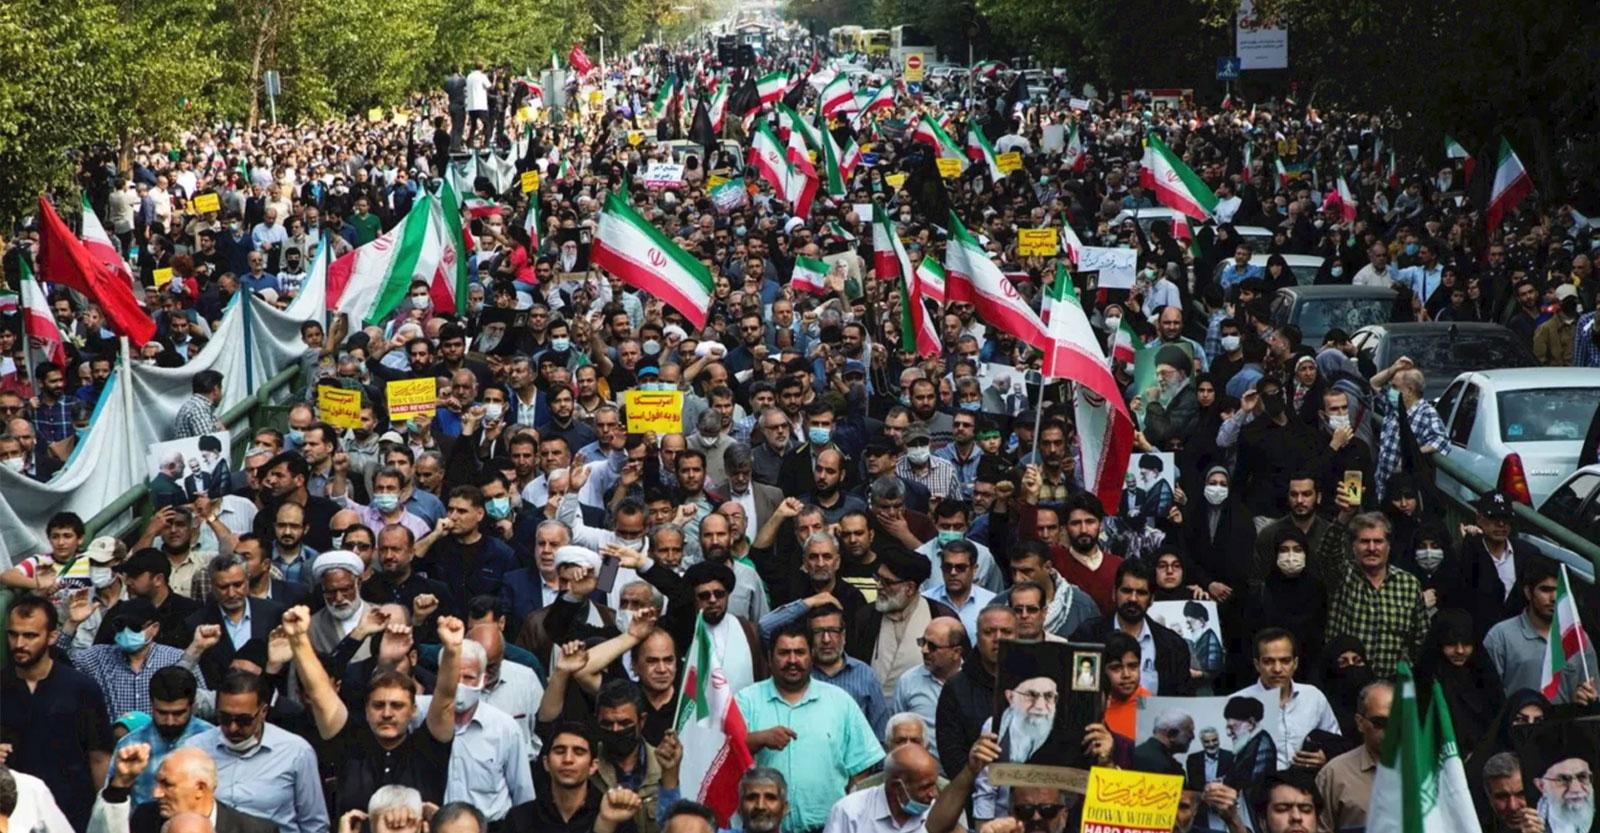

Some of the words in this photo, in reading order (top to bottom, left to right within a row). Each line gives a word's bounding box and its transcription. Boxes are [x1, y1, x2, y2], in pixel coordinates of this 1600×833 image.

[629, 410, 646, 420] است
[645, 409, 664, 422] افول
[1087, 807, 1122, 823] DOWN
[1126, 810, 1152, 826] WITH
